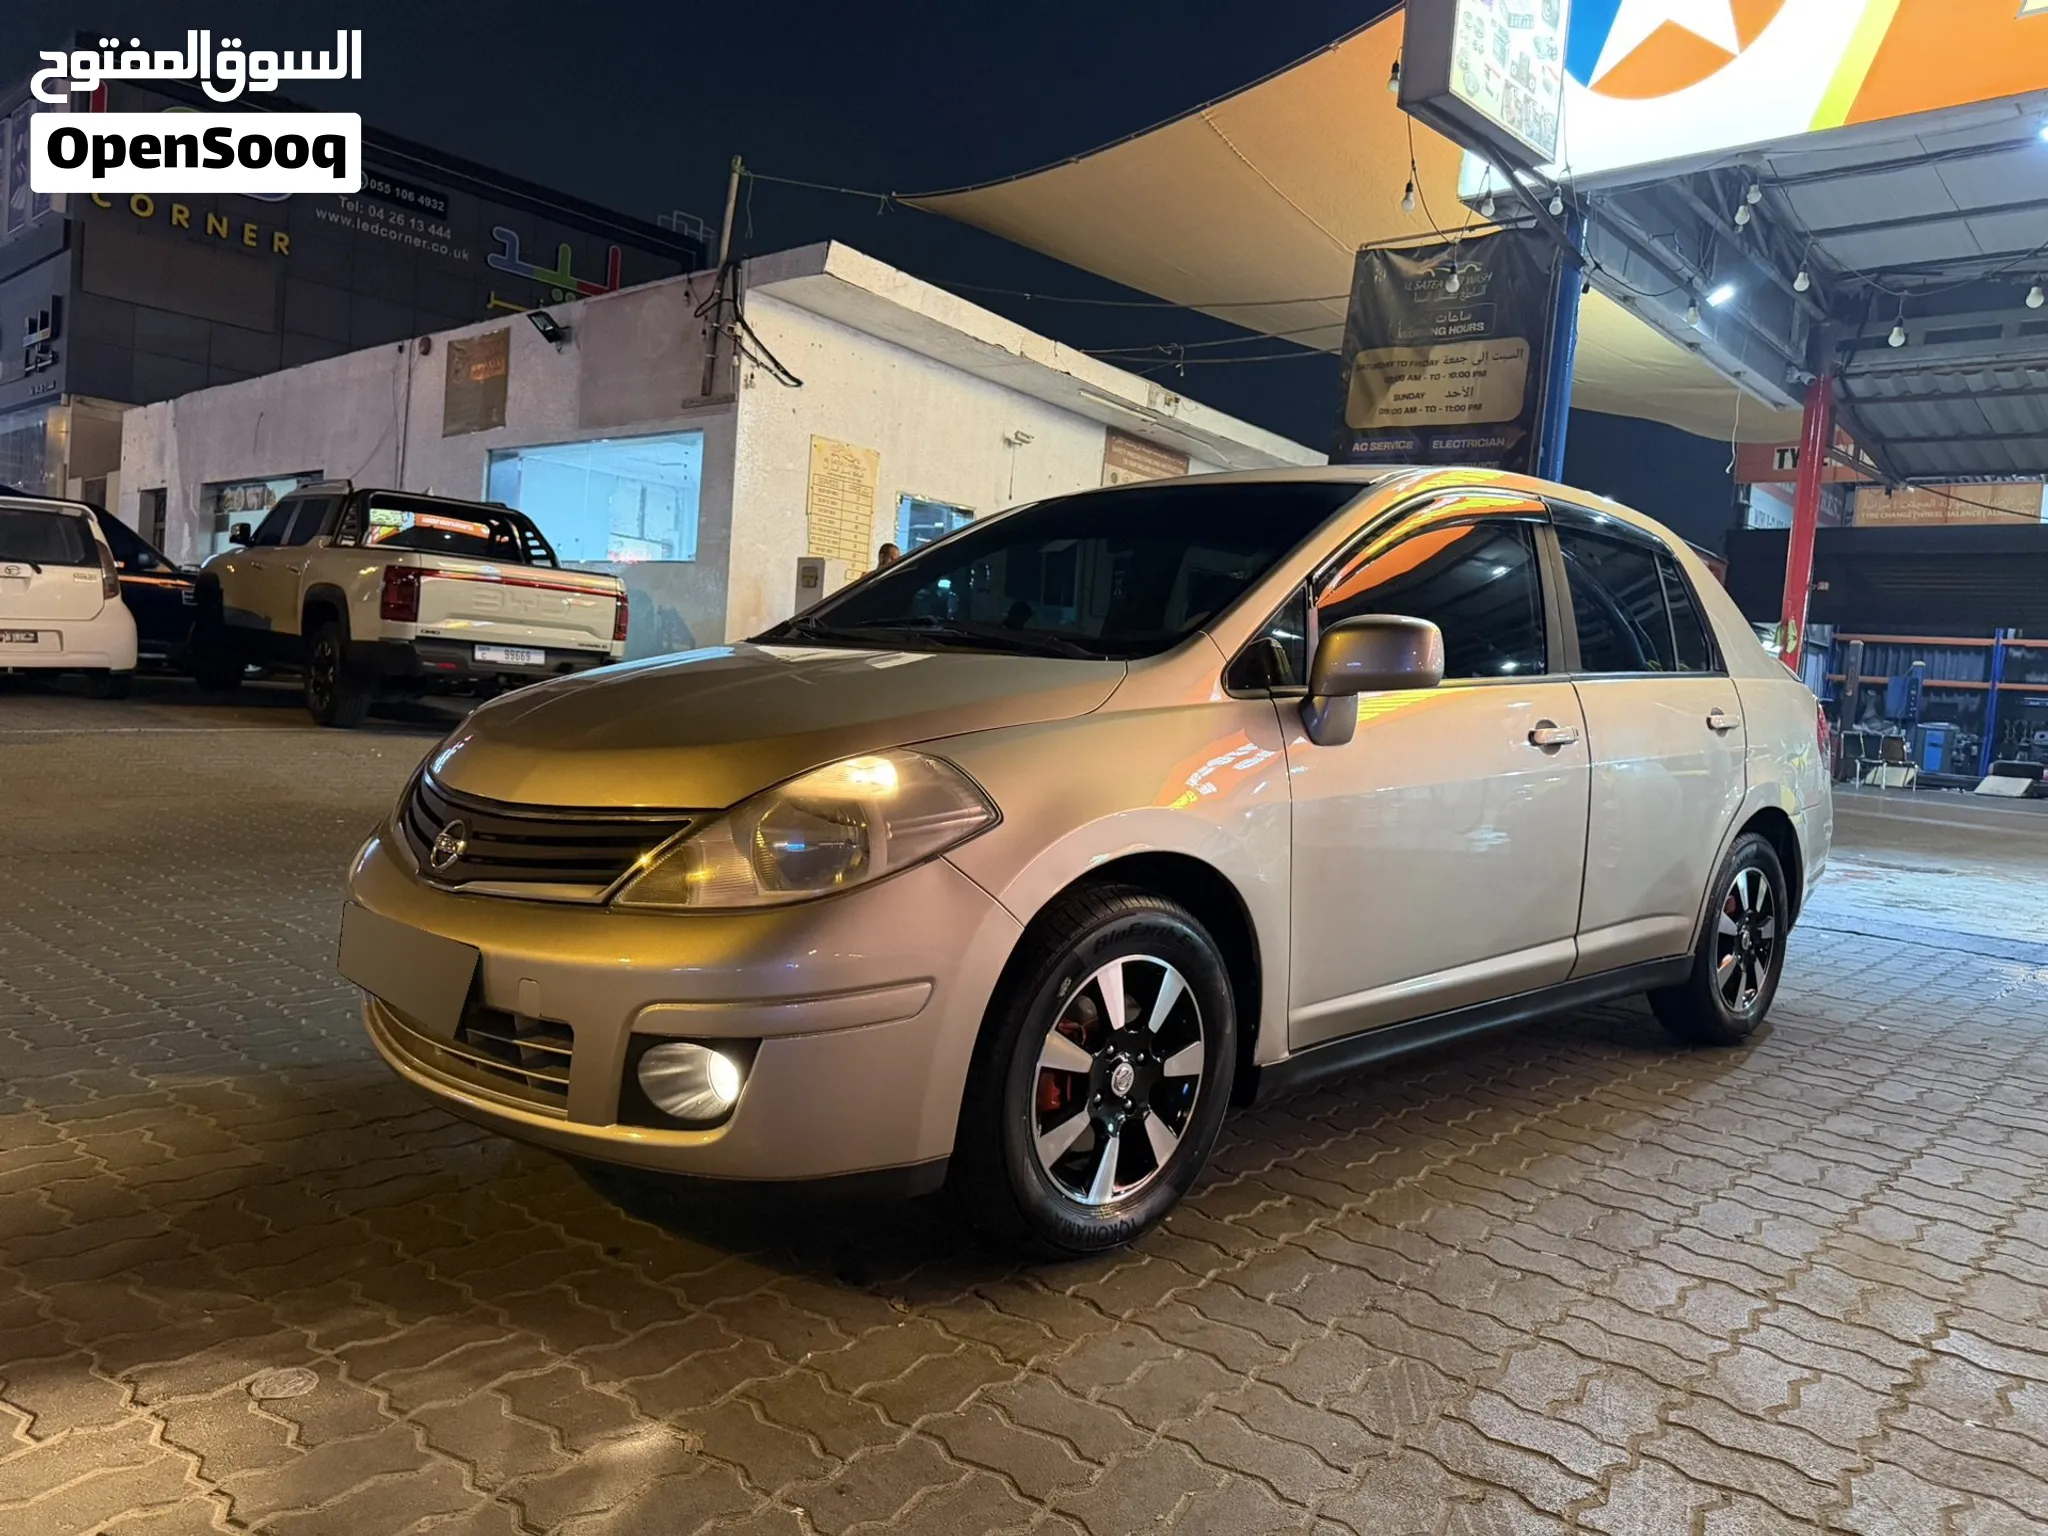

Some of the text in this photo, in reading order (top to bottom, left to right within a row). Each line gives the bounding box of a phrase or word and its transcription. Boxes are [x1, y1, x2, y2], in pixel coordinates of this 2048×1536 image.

[370, 179, 445, 212] 055 106 4932
[338, 195, 452, 240] Tel: 04 26 13 444
[315, 207, 470, 262] www.ledcorner.co.uk
[1448, 322, 1485, 335] HOURS
[1407, 373, 1422, 381] AM
[1472, 370, 1487, 378] PM
[1393, 392, 1425, 401] SUNDAY
[1444, 386, 1474, 399] الأحد
[1404, 406, 1418, 414] AM
[1468, 403, 1482, 411] PM
[1352, 440, 1414, 451] AC SERVICE
[1432, 437, 1506, 449] ELECTRICIAN
[504, 648, 531, 661] 99669
